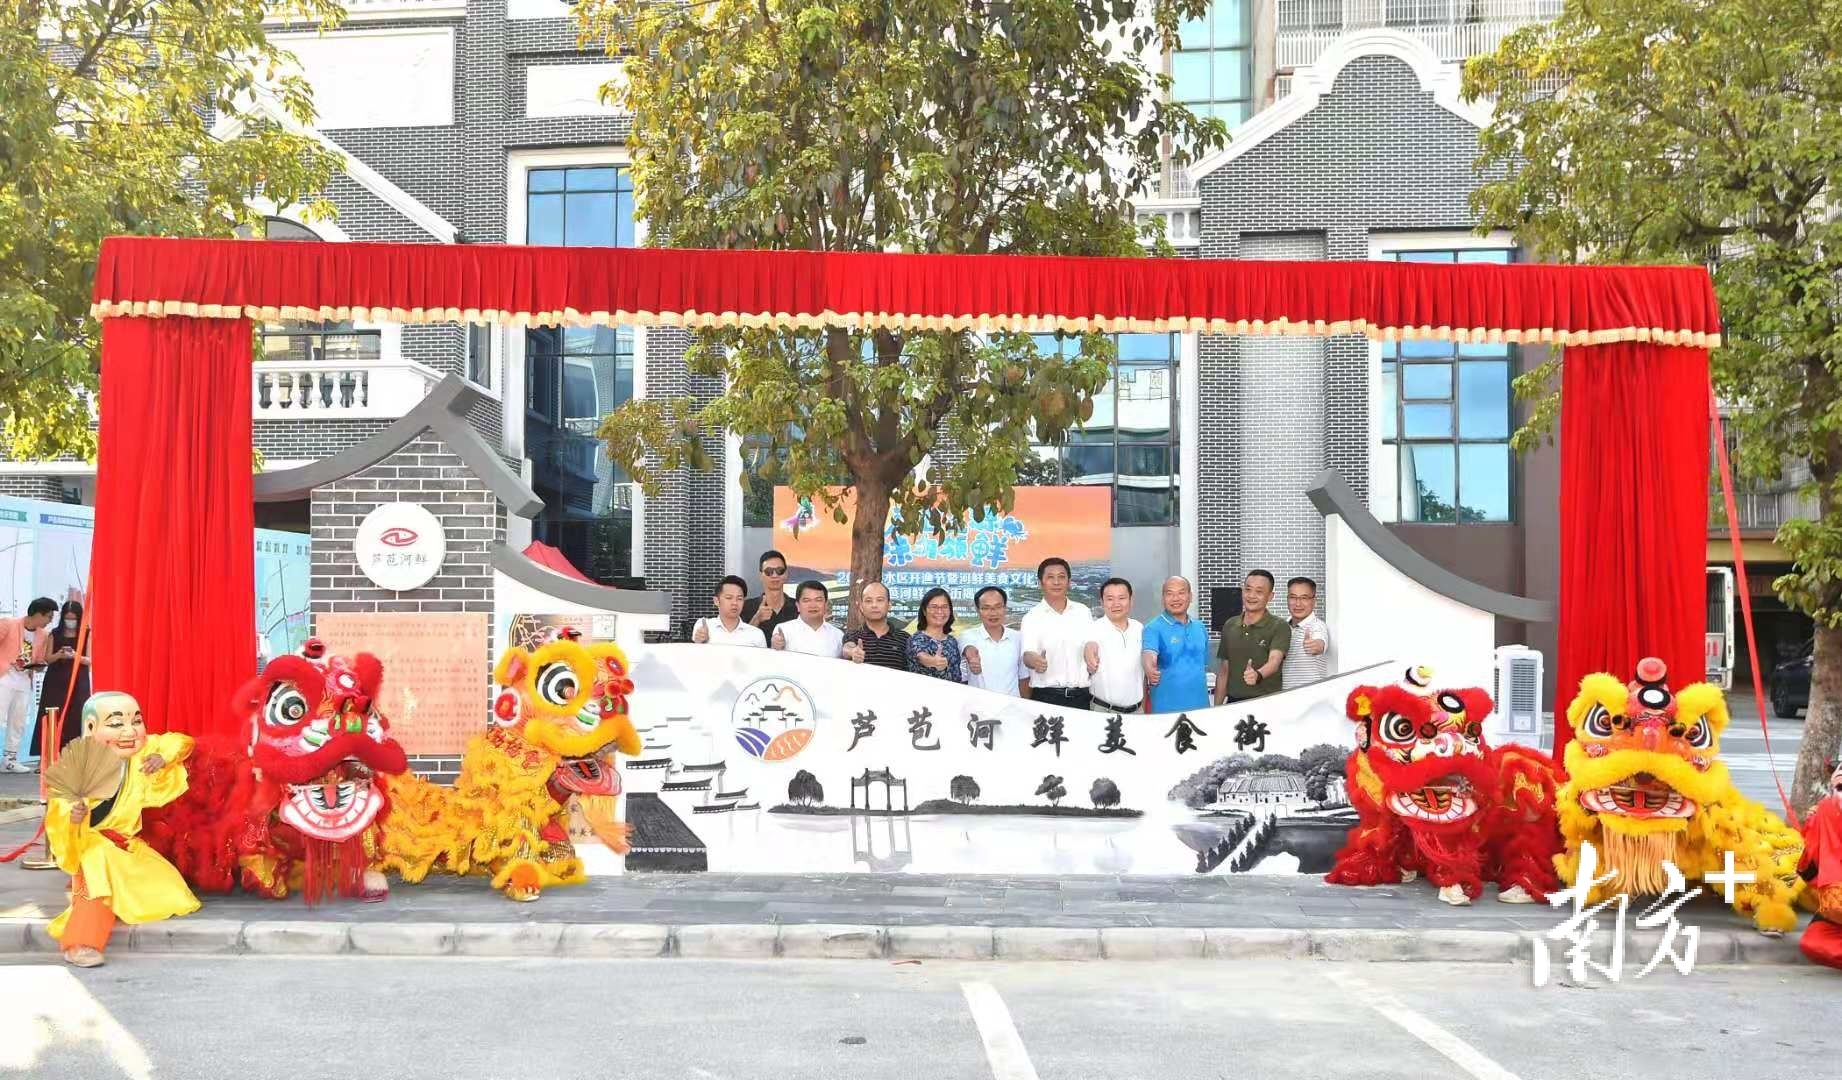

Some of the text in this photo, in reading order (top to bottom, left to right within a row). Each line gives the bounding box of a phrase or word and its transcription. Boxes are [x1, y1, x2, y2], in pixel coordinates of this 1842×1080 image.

[846, 705, 1273, 758] 芦苞河鲜美食街
